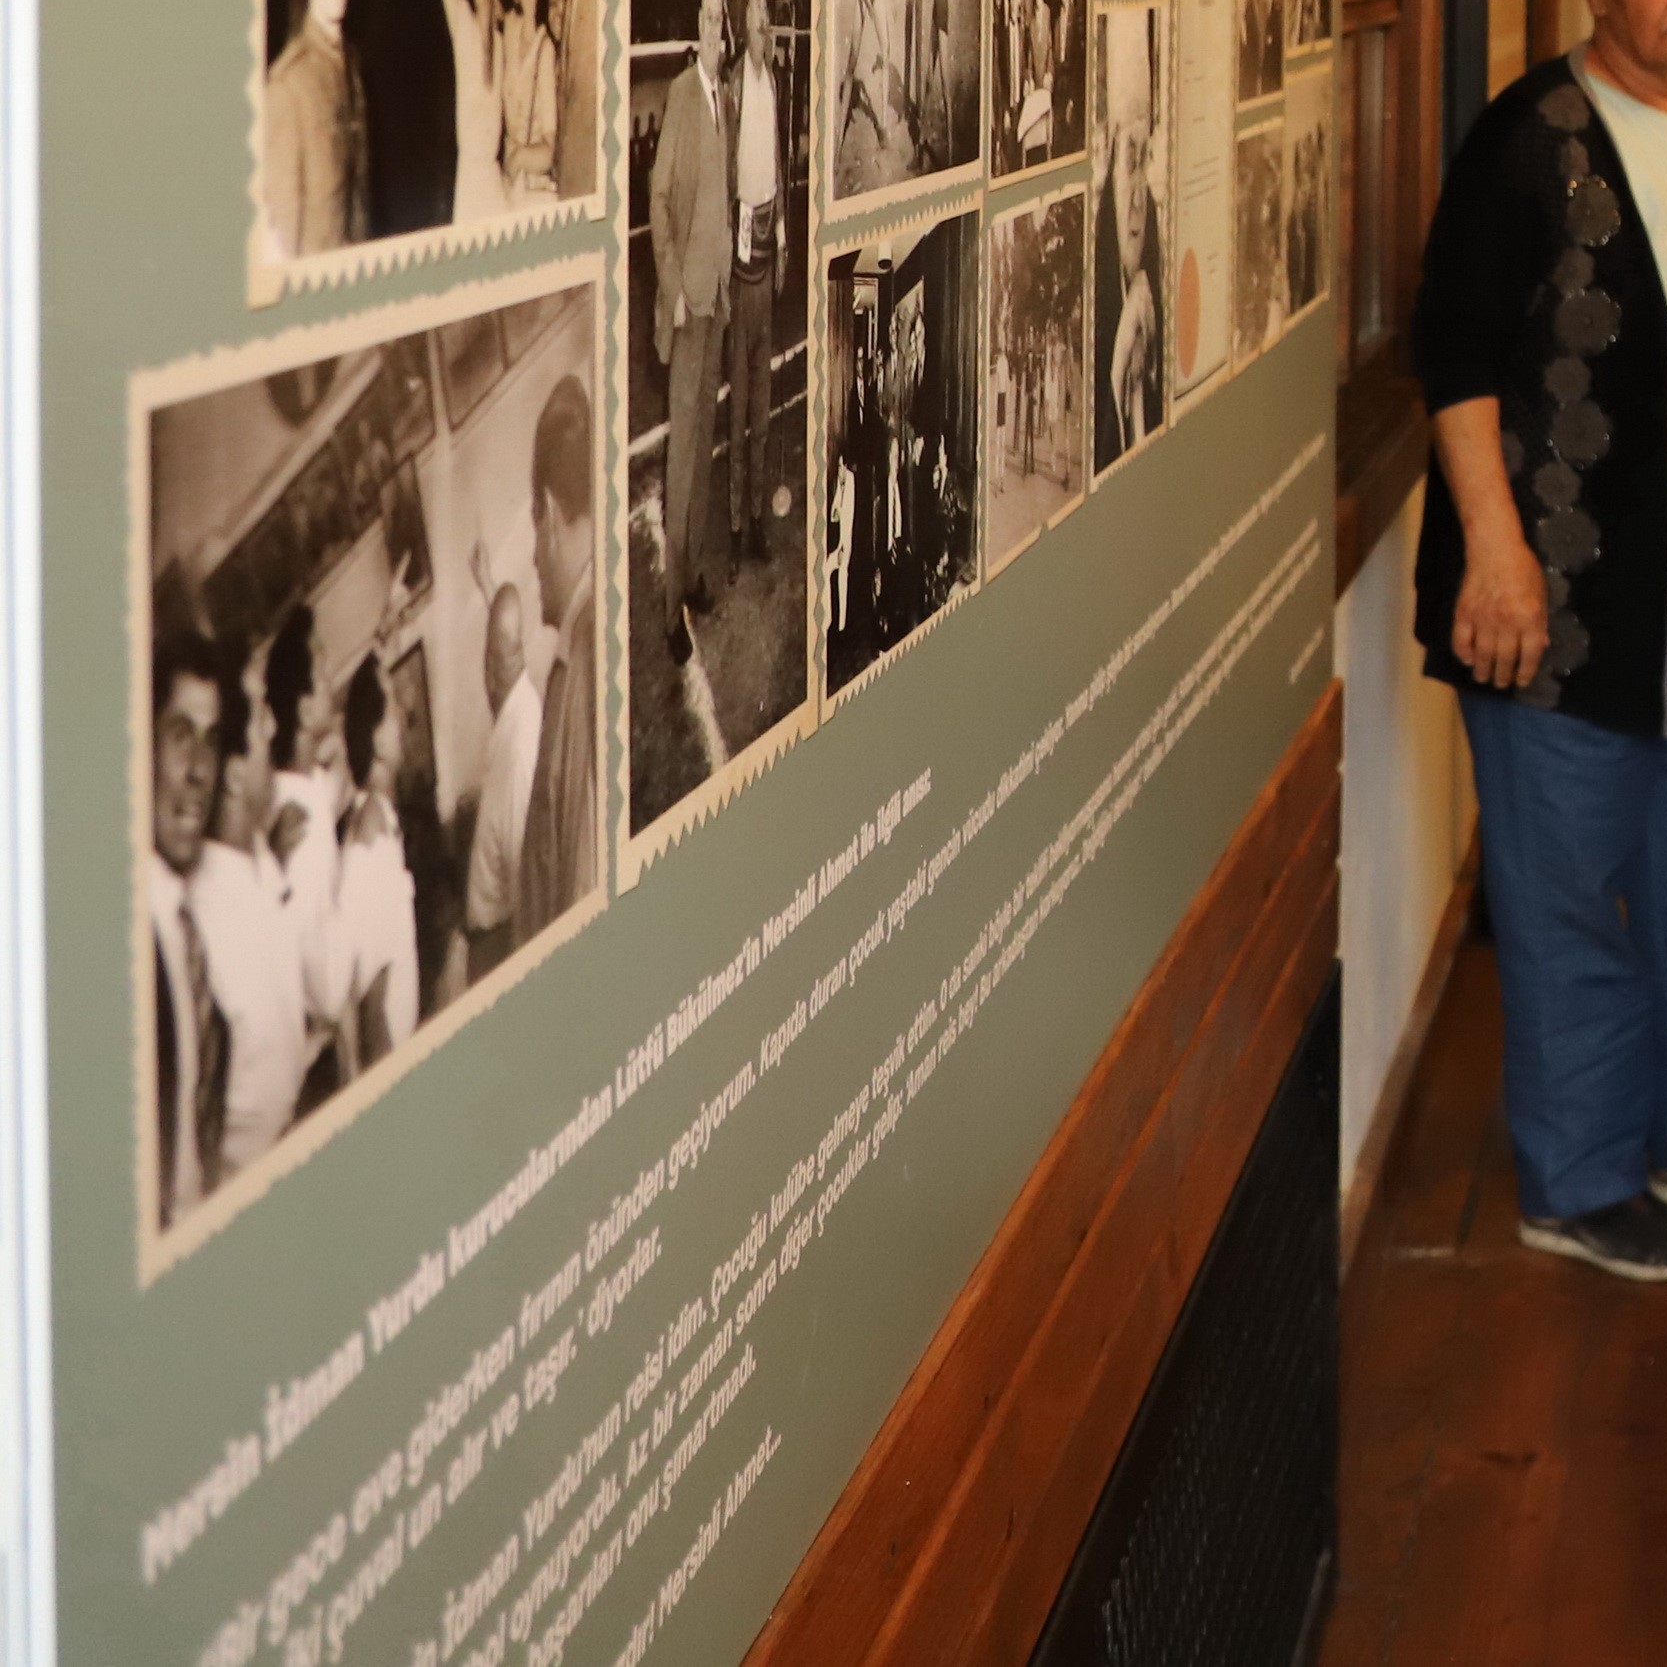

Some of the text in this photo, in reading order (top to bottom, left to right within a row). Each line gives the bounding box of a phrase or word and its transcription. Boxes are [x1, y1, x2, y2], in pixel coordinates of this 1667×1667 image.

[141, 1435, 261, 1582] Mersin
[264, 1332, 364, 1460] İdman
[367, 1251, 445, 1353] Yurdu
[448, 1085, 613, 1277] kurucularından
[615, 1022, 664, 1108] Lütfü
[666, 937, 760, 1057] Bükülmez'in
[762, 873, 816, 959] Mersinli
[817, 834, 859, 904] Ahmet
[860, 821, 876, 860] ile
[876, 789, 901, 846] ilgili
[267, 1514, 348, 1645] gece
[351, 1451, 404, 1534] eve
[407, 1326, 515, 1487] giderken
[518, 1252, 581, 1348] fırının
[584, 1158, 665, 1272] önünden
[668, 1061, 757, 1191] geçiyorum.
[759, 1000, 807, 1077] Kapıda
[809, 957, 847, 1020] duran
[848, 910, 885, 988] çocuk
[886, 859, 927, 943] yaştaki
[927, 827, 961, 896] gencin
[407, 1482, 443, 1549] un
[445, 1427, 488, 1505] alır
[491, 1392, 520, 1450] ve
[586, 1226, 662, 1337] diyorlar.
[441, 1534, 519, 1661] İdman
[523, 1403, 621, 1551] Yurdu'nun
[625, 1334, 665, 1423] reisi
[667, 1297, 707, 1368] idim.
[710, 1212, 767, 1323] Çocuğu
[770, 1154, 815, 1234] kulübe
[817, 1084, 870, 1181] gelmeye
[871, 1034, 906, 1100] teşvik
[907, 999, 938, 1054] ettim.
[939, 978, 948, 1012] O
[948, 965, 962, 1000] da
[962, 924, 988, 982] sanki
[509, 1473, 621, 1642] oynuyordu.
[625, 1428, 650, 1488] Az
[652, 1390, 677, 1450] bir
[678, 1318, 733, 1415] zaman
[735, 1258, 777, 1336] sonra
[779, 1206, 816, 1275] diğer
[817, 1131, 872, 1238] çocuklar
[872, 1089, 904, 1160] gelip:
[937, 1016, 957, 1062] reis
[957, 983, 979, 1035] bey!
[625, 1476, 660, 1548] onu
[662, 1343, 756, 1511] şımartmadı.
[658, 1425, 782, 1627] Mersinli Ahmet...
